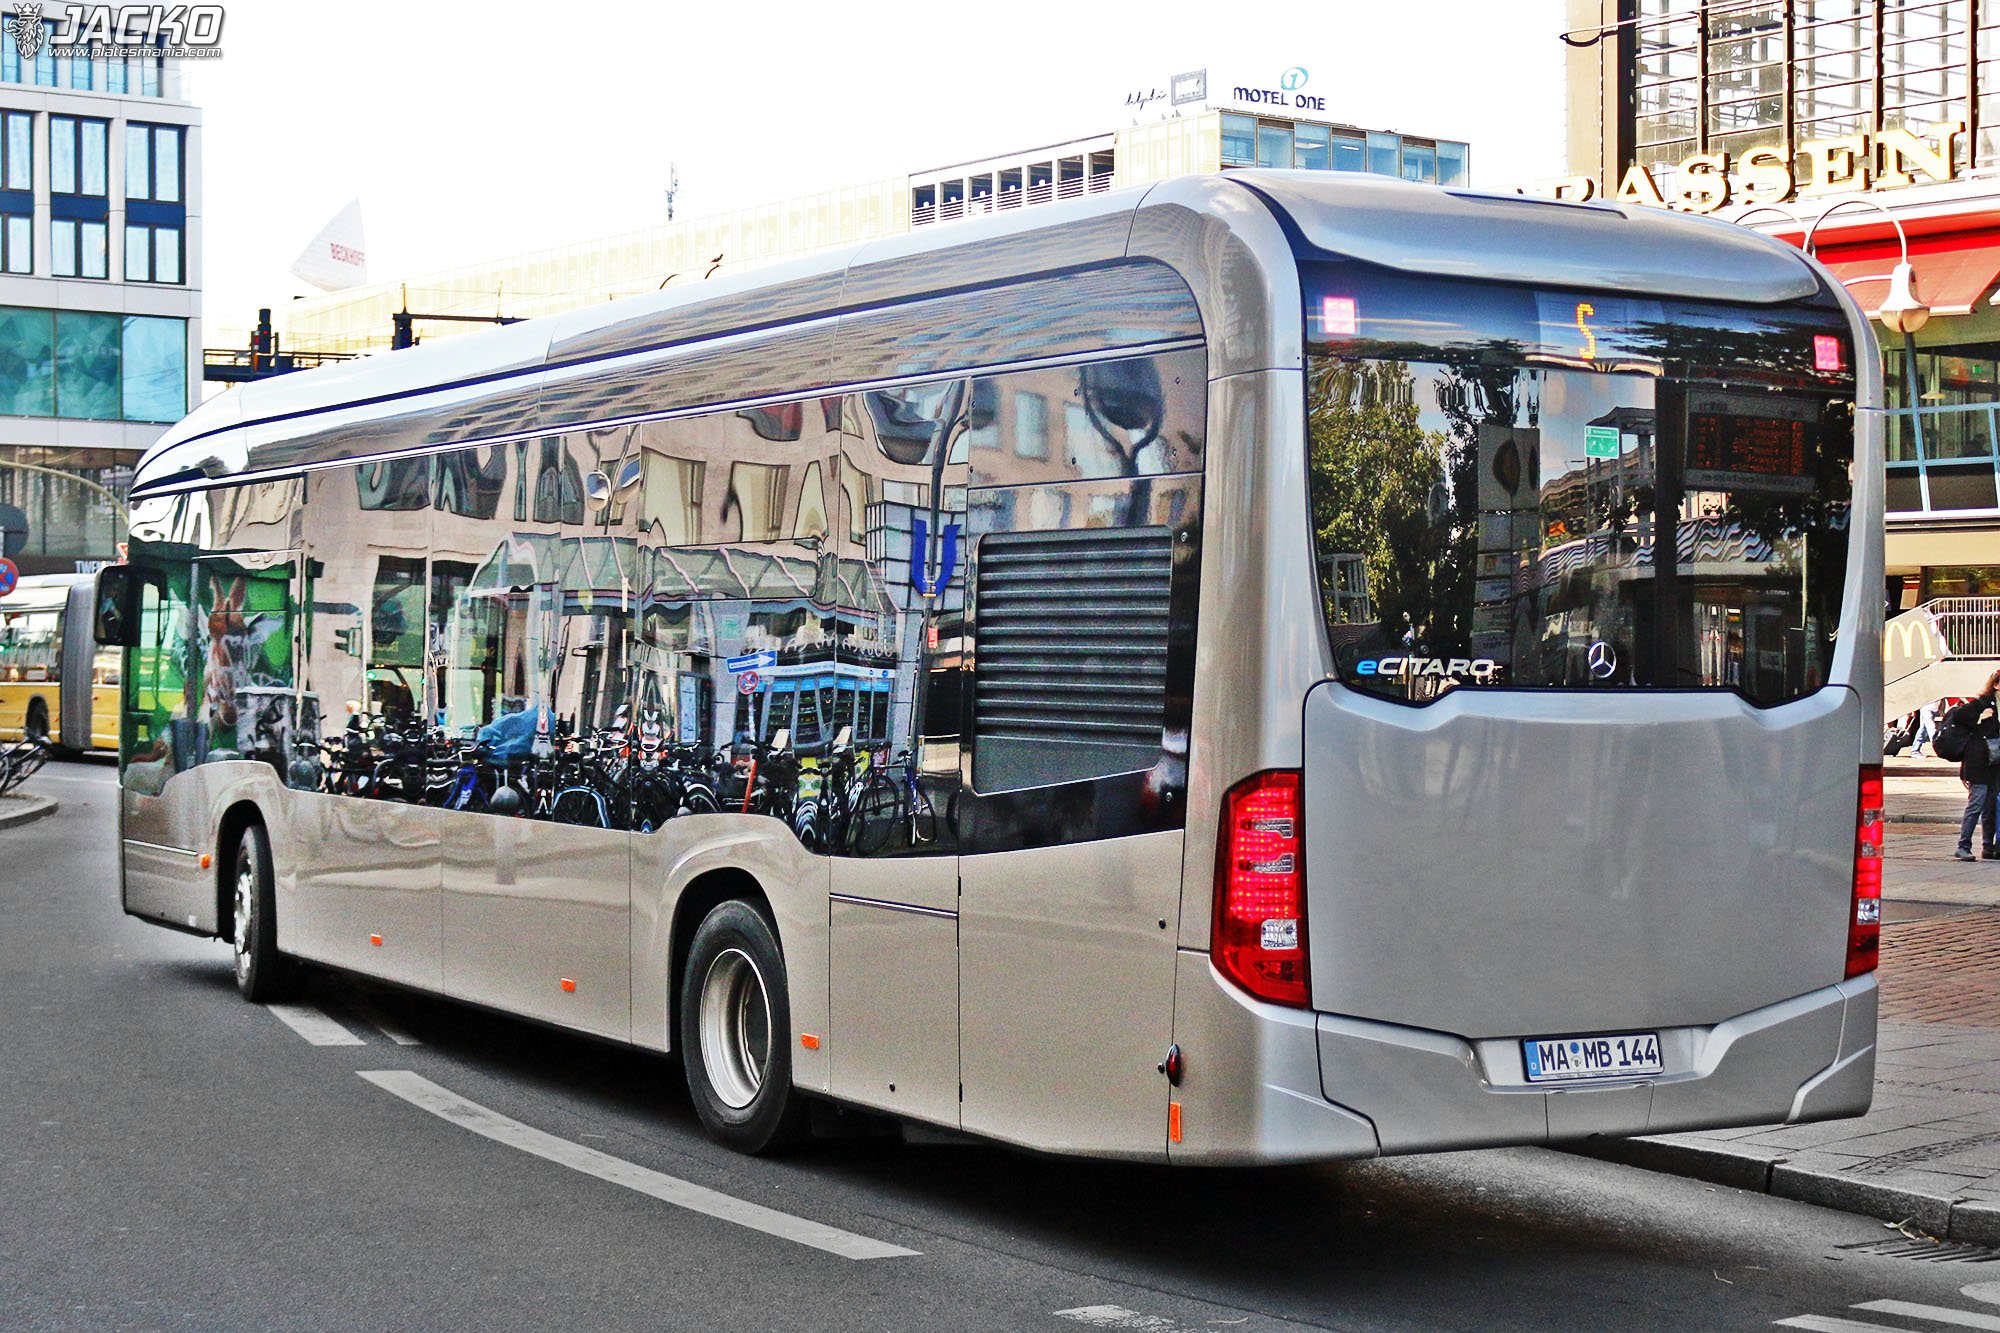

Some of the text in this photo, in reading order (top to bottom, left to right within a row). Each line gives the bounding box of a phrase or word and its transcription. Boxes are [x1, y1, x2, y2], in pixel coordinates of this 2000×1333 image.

[1233, 86, 1326, 111] MOTEL ONE
[1356, 658, 1496, 677] eCITARO
[1539, 1042, 1570, 1071] MA
[1582, 1040, 1613, 1069] MB
[1617, 1038, 1658, 1067] 144
